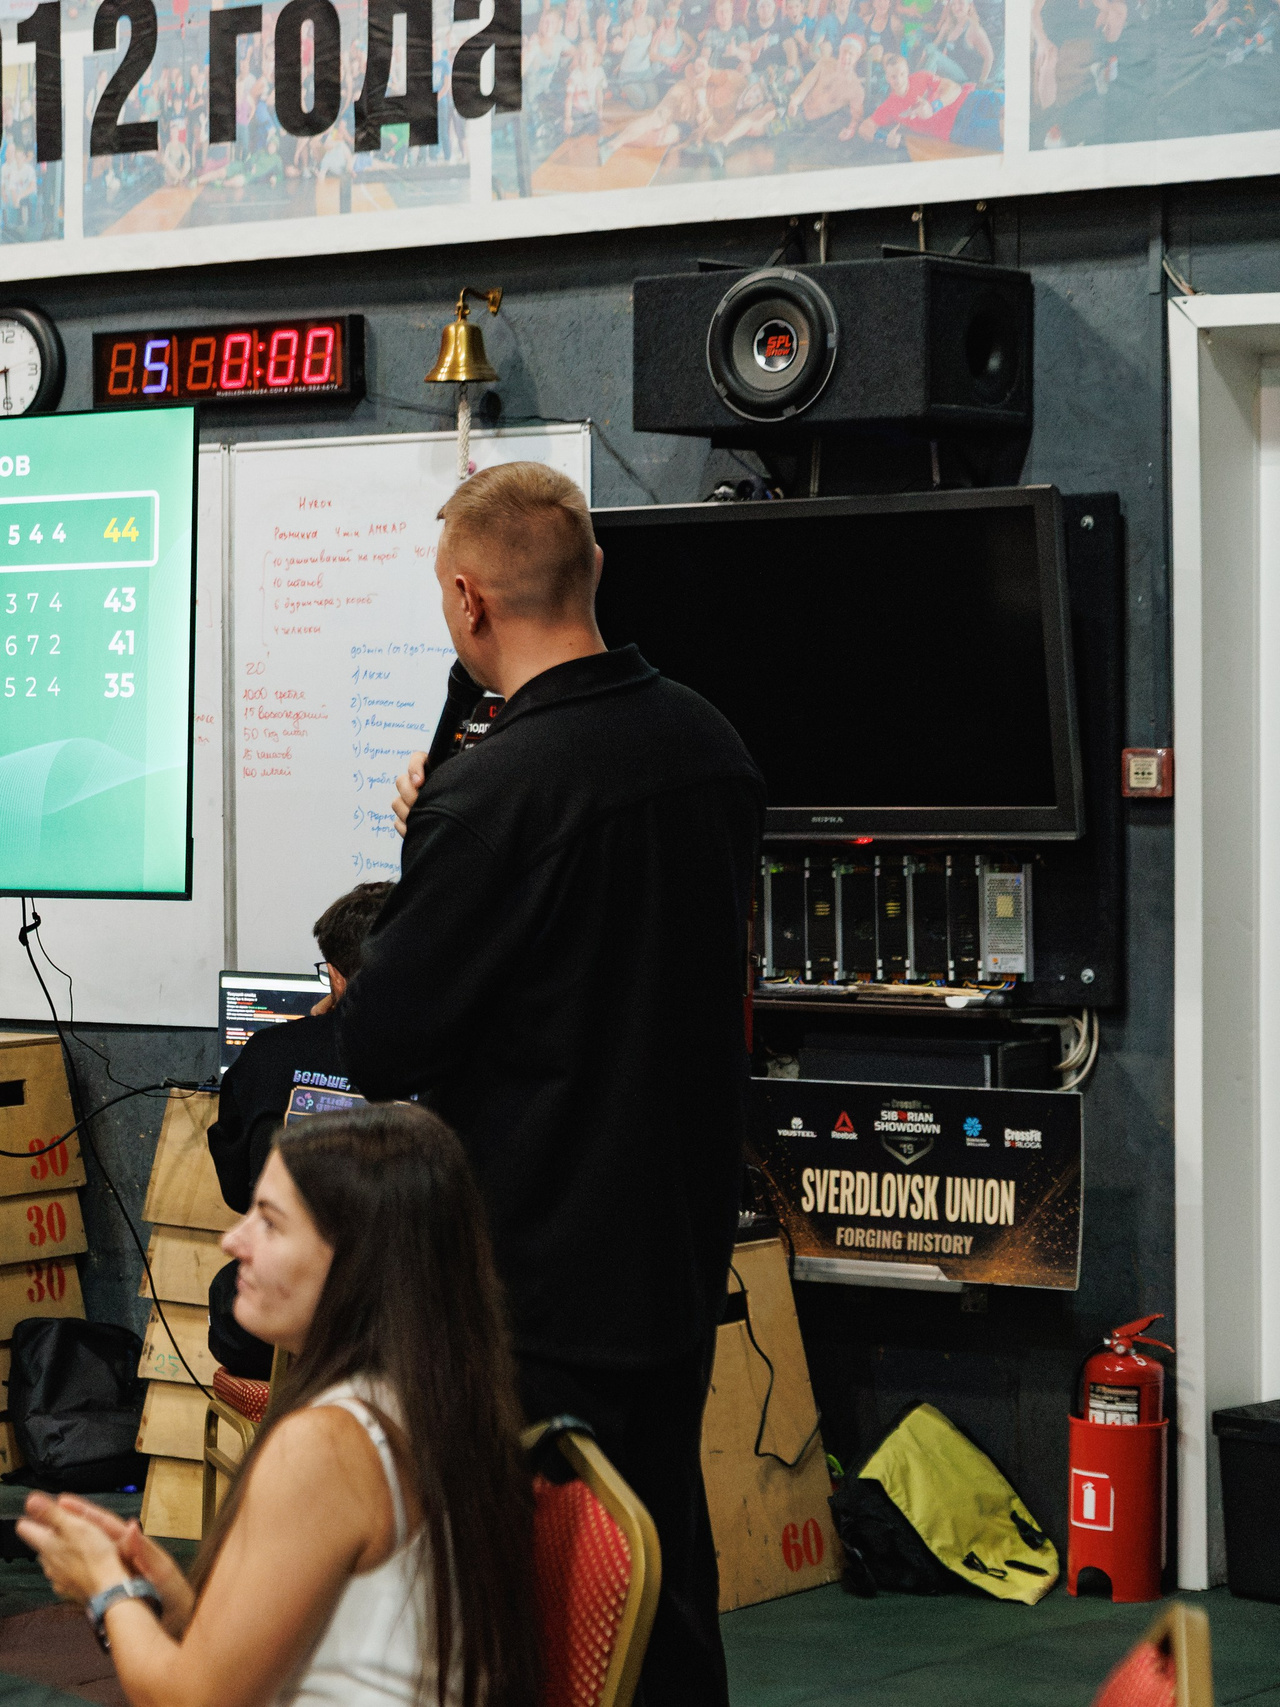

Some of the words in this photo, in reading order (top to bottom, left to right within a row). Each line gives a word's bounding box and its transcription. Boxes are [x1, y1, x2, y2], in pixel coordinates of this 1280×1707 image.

[207, 0, 522, 153] года
[1, 330, 15, 344] 12
[767, 334, 792, 349] SPL
[27, 362, 38, 377] 3
[8, 524, 20, 546] 5
[29, 523, 44, 544] 4
[52, 522, 67, 543] 4
[103, 516, 140, 543] 44
[5, 593, 17, 614] 3
[27, 592, 39, 613] 7
[49, 592, 63, 612] 4
[103, 586, 137, 613] 43
[5, 635, 18, 656] 6
[27, 634, 40, 656] 7
[49, 634, 61, 655] 2
[108, 629, 135, 655] 41
[4, 677, 16, 698] 5
[25, 676, 37, 698] 2
[47, 676, 61, 697] 4
[103, 672, 135, 698] 35
[874, 1119, 941, 1135] SHOWDOWN
[28, 1134, 70, 1181] 30
[801, 1167, 940, 1221] SVERDLOVSK
[945, 1175, 1016, 1226] UNION
[26, 1201, 67, 1247] 30
[835, 1227, 904, 1250] FORGING
[906, 1231, 974, 1256] HISTORY
[26, 1261, 67, 1303] 30
[154, 1353, 179, 1377] 25
[782, 1517, 825, 1573] 60
